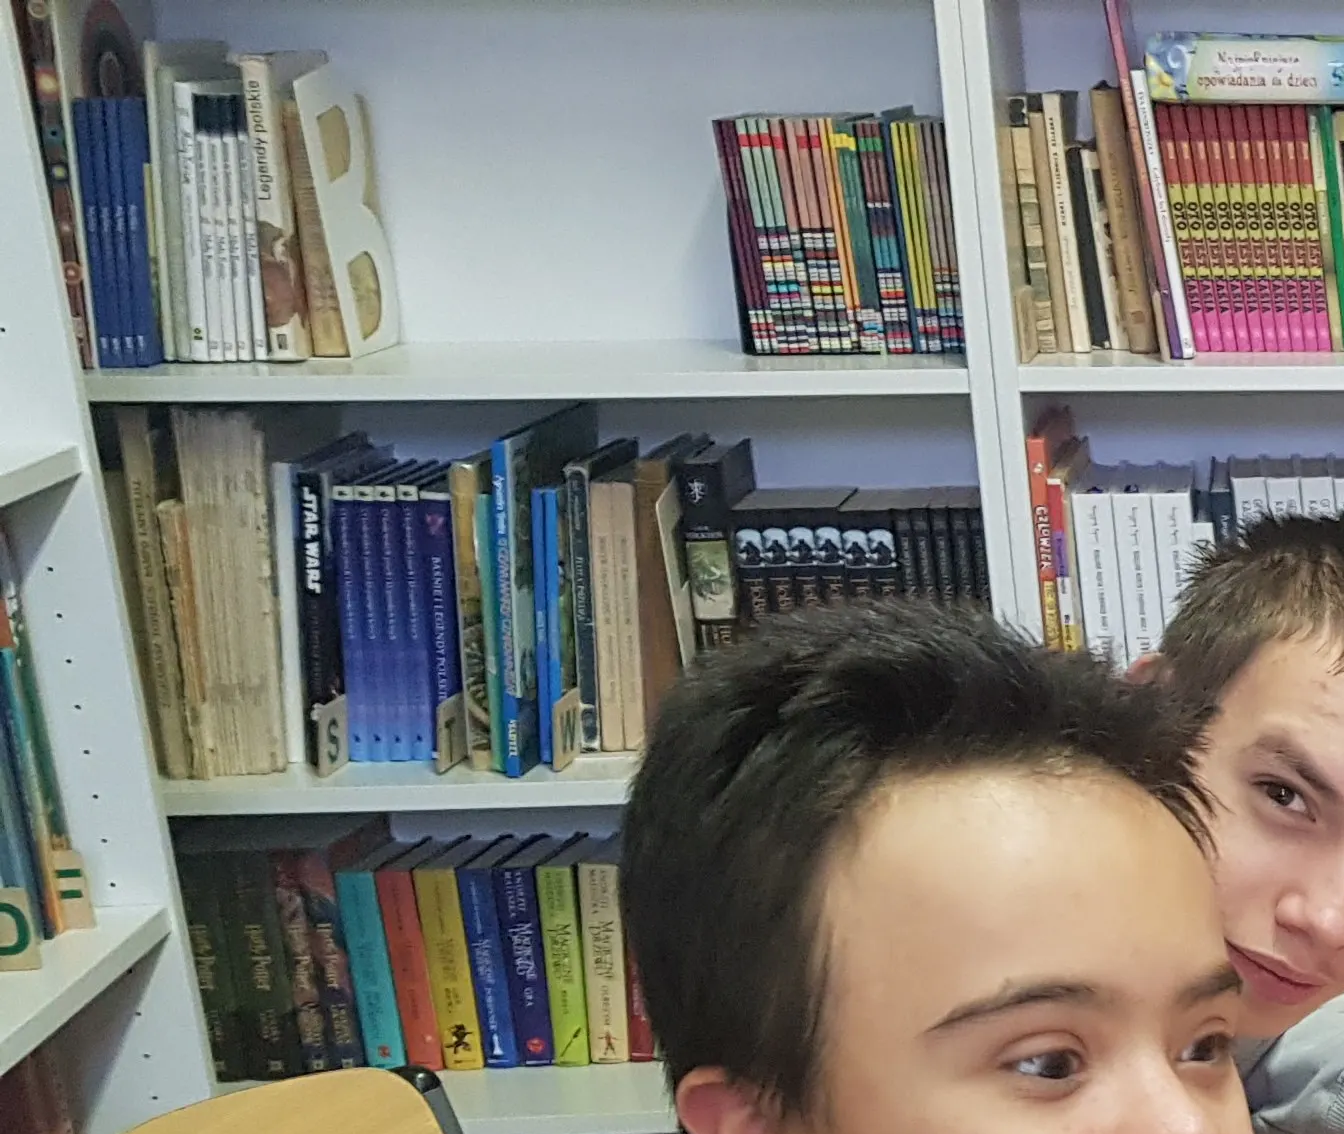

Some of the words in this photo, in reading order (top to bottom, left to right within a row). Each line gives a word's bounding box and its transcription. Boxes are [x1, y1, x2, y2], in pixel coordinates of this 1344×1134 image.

[247, 80, 264, 133] polskie
[1196, 73, 1266, 90] opowiadania
[252, 138, 272, 201] Legendy
[1174, 202, 1186, 231] OTO
[1186, 275, 1201, 313] KASIA
[1188, 202, 1200, 231] OTO
[1199, 275, 1214, 313] KASIA
[1205, 202, 1217, 231] OTO
[1214, 275, 1229, 313] KASIA
[1219, 202, 1231, 231] OTO
[1228, 275, 1243, 313] KASIA
[1234, 202, 1246, 231] OTO
[1243, 275, 1258, 313] KASIA
[1248, 202, 1260, 231] OTO
[1256, 275, 1272, 313] KASIA
[1262, 202, 1274, 231] OTO
[1270, 275, 1286, 313] KASIA
[1277, 202, 1289, 231] OTO
[1284, 275, 1299, 313] KASIA
[1290, 202, 1302, 231] OTO
[1297, 275, 1312, 313] KASIA
[1304, 202, 1316, 231] OTO
[1311, 275, 1326, 313] KASIA
[302, 487, 319, 537] STAR
[304, 542, 322, 594] WARS
[433, 604, 446, 653] LEGENDY
[559, 708, 578, 755] W
[253, 955, 273, 991] Potter
[601, 920, 616, 982] MAGICZNE
